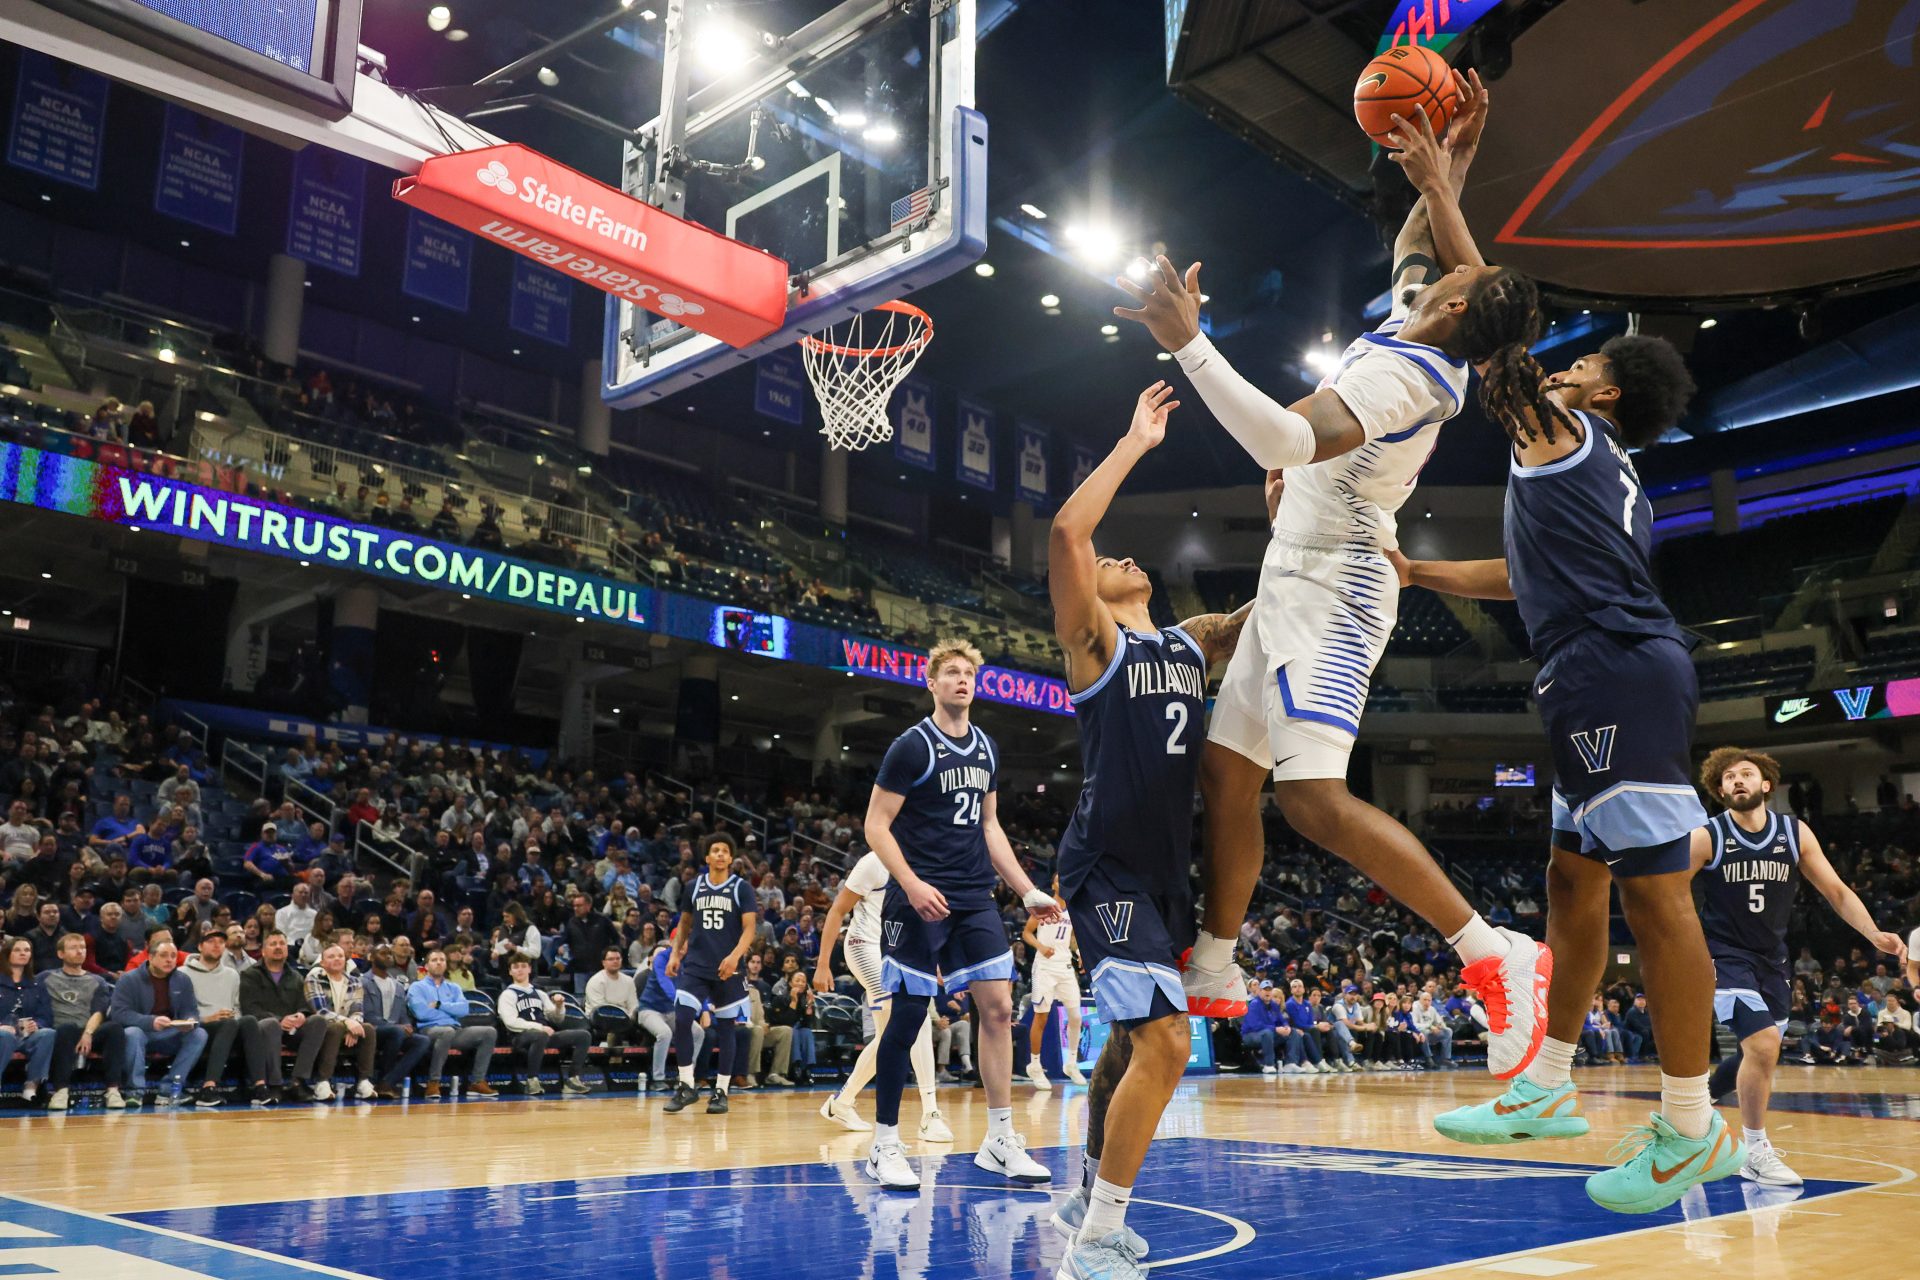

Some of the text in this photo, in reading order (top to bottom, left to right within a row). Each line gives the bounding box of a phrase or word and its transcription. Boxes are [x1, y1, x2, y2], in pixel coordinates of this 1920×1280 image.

[40, 96, 82, 119] NCAA
[183, 146, 220, 169] NCAA
[302, 205, 338, 225] SWEET
[309, 194, 346, 217] NCAA
[416, 244, 450, 265] SWEET
[423, 235, 457, 256] NCAA
[907, 418, 926, 433] 40
[118, 476, 645, 624] WINTRUST.COM/DEPAUL
[1126, 660, 1204, 704] VILLANOVA
[1780, 697, 1811, 714] NIKE
[1165, 701, 1188, 755] 2
[939, 766, 991, 795] VILLANOV
[953, 791, 981, 825] 24
[1722, 860, 1790, 883] VILLANOVA
[696, 895, 733, 912] VILLANOVA
[1748, 883, 1765, 913] 5
[702, 909, 724, 930] 55
[1056, 926, 1066, 940] 11
